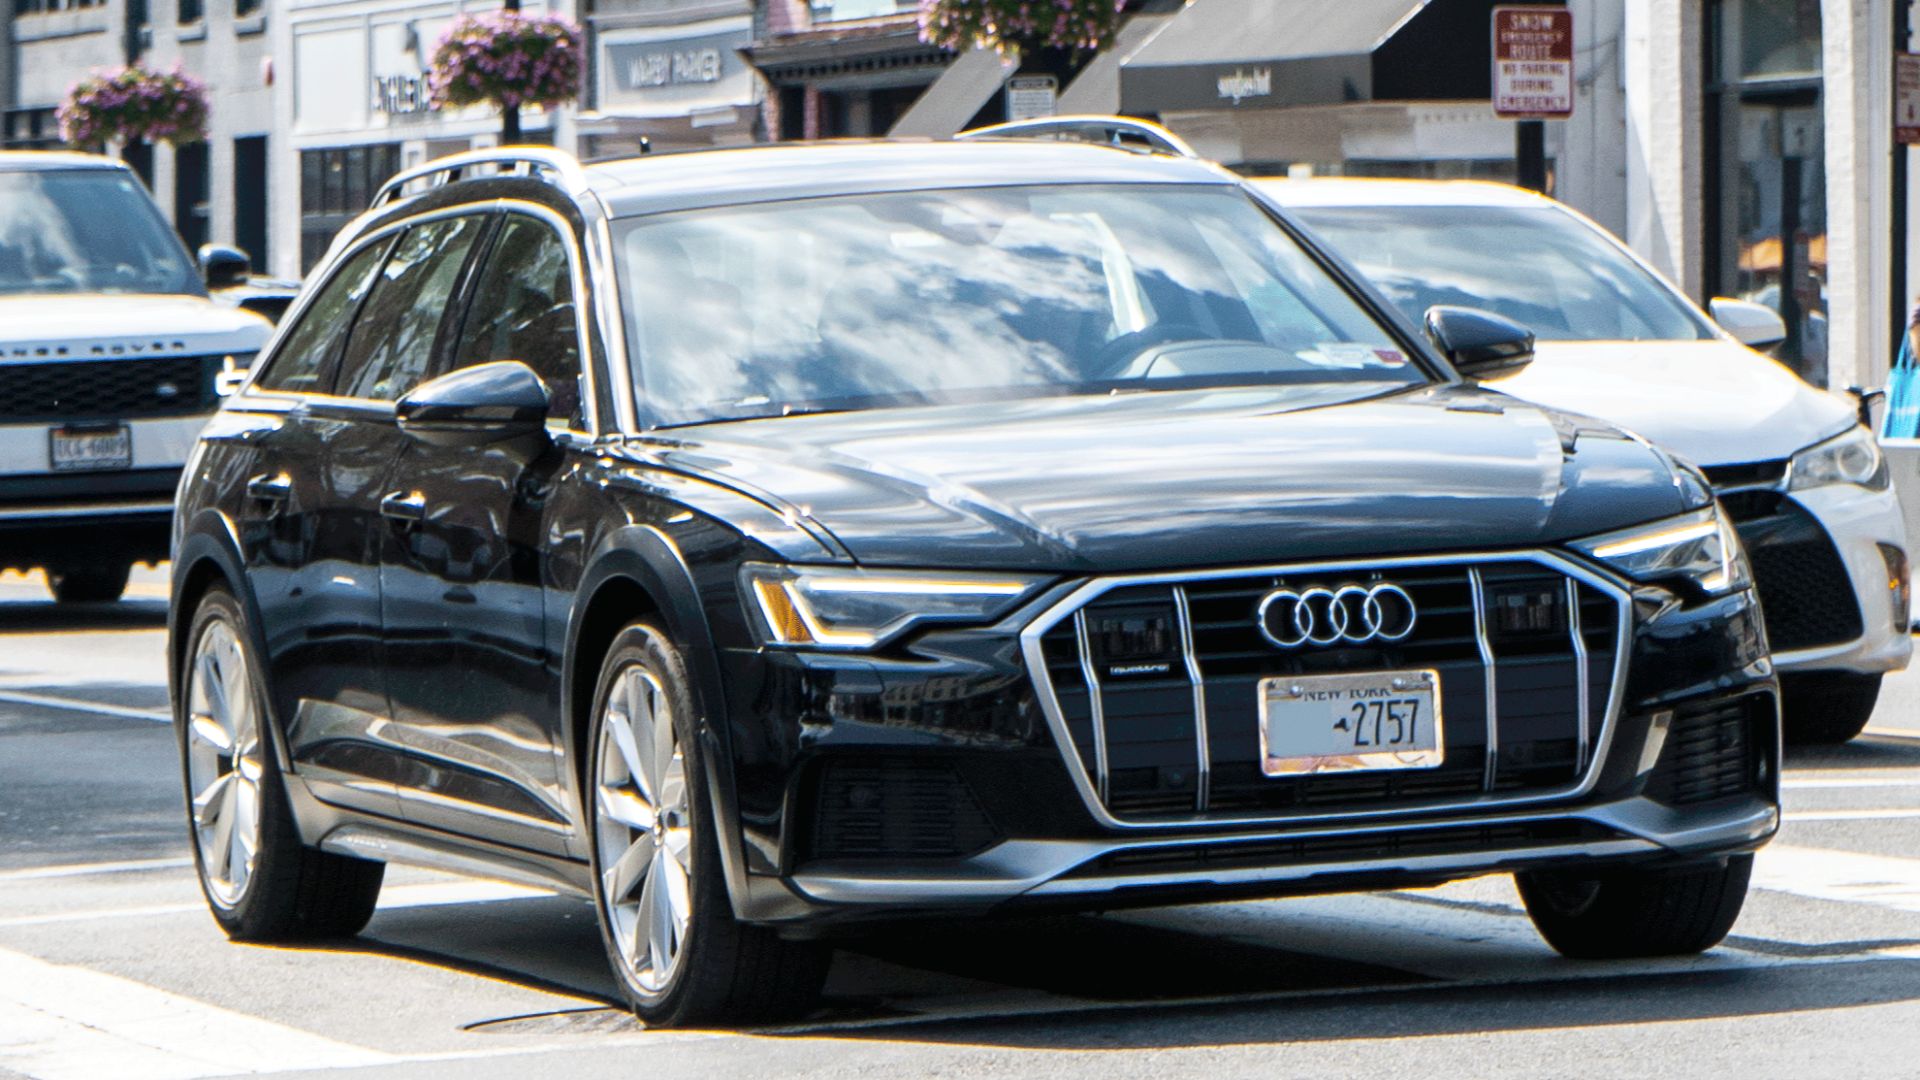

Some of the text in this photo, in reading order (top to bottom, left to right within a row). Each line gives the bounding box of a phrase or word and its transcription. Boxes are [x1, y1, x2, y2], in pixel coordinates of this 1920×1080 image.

[1510, 13, 1553, 30] SNOW
[1501, 32, 1564, 43] EMERGENCY
[1509, 44, 1552, 59] ROUTE
[1520, 63, 1564, 76] PARKING
[1511, 80, 1552, 92] DURING
[1501, 95, 1566, 109] EMERGENCY
[90, 340, 184, 354] ROVER
[1352, 698, 1420, 747] 2757
